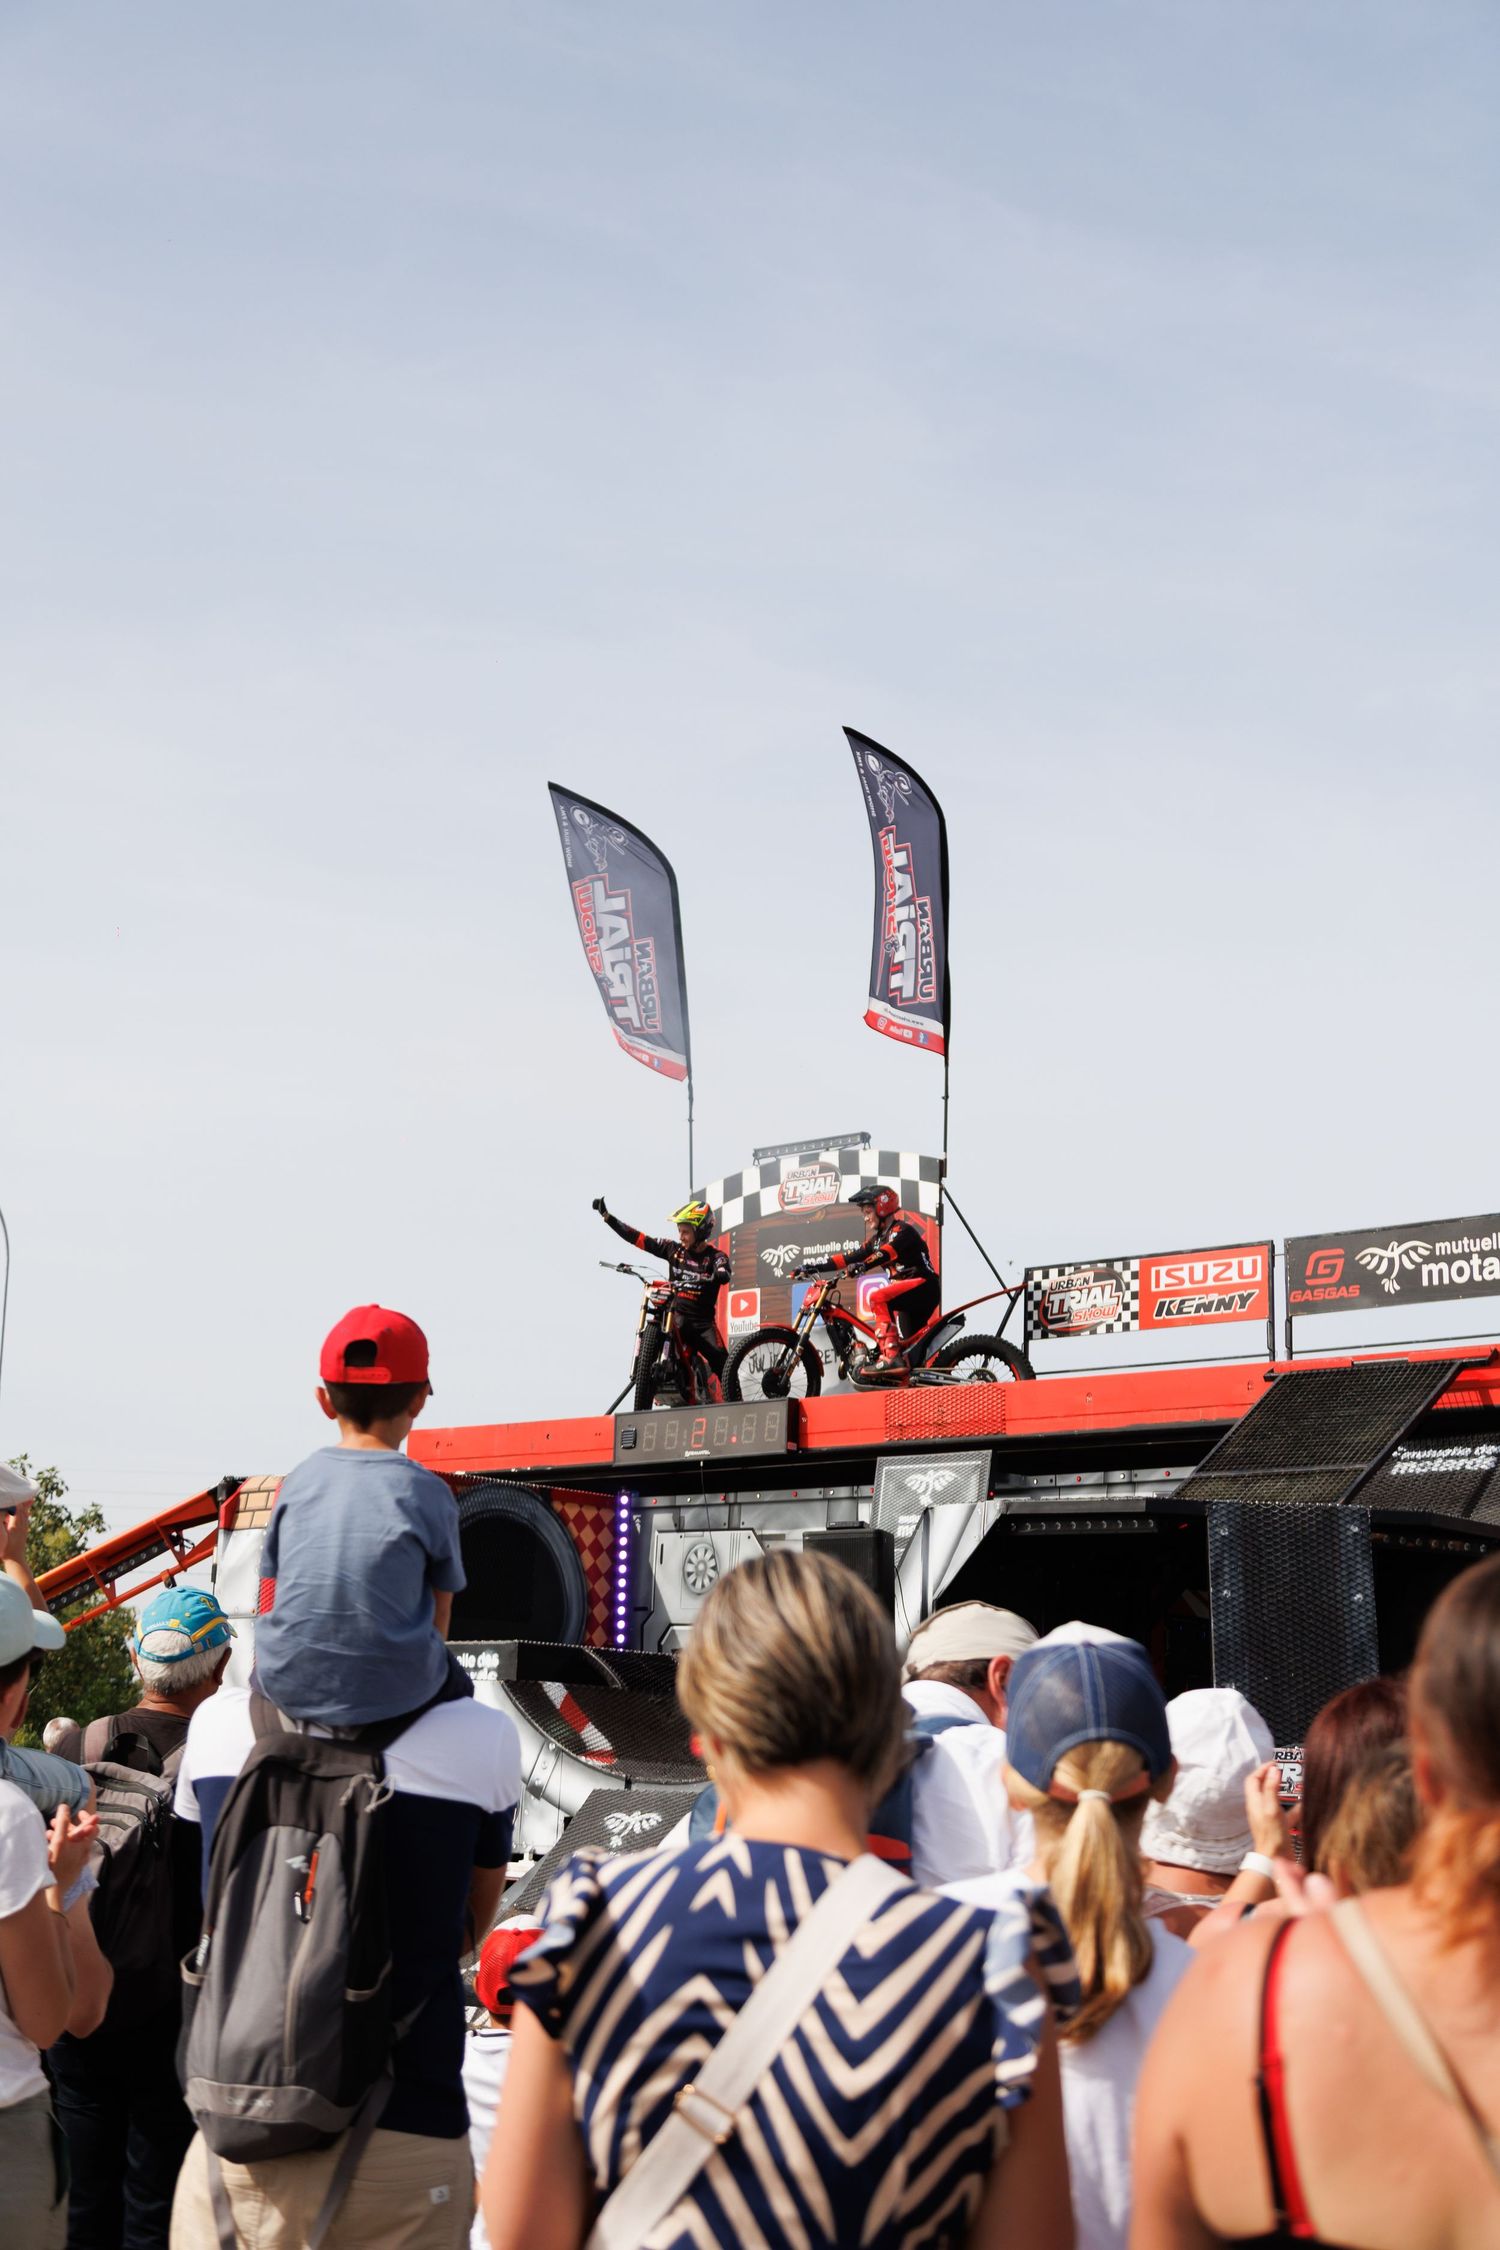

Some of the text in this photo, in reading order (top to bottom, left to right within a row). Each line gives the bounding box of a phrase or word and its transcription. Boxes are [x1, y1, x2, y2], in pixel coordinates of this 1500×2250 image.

[787, 1168, 817, 1179] URBAN
[786, 1175, 836, 1198] TRIAL
[803, 1242, 841, 1255] mutuelle
[1050, 1275, 1091, 1291] URBAN
[1155, 1258, 1258, 1289] ISUZU
[1048, 1283, 1119, 1315] TRIAL
[1289, 1284, 1361, 1303] GASGAS
[1072, 1305, 1117, 1321] SHOW
[1154, 1290, 1259, 1318] KENNY
